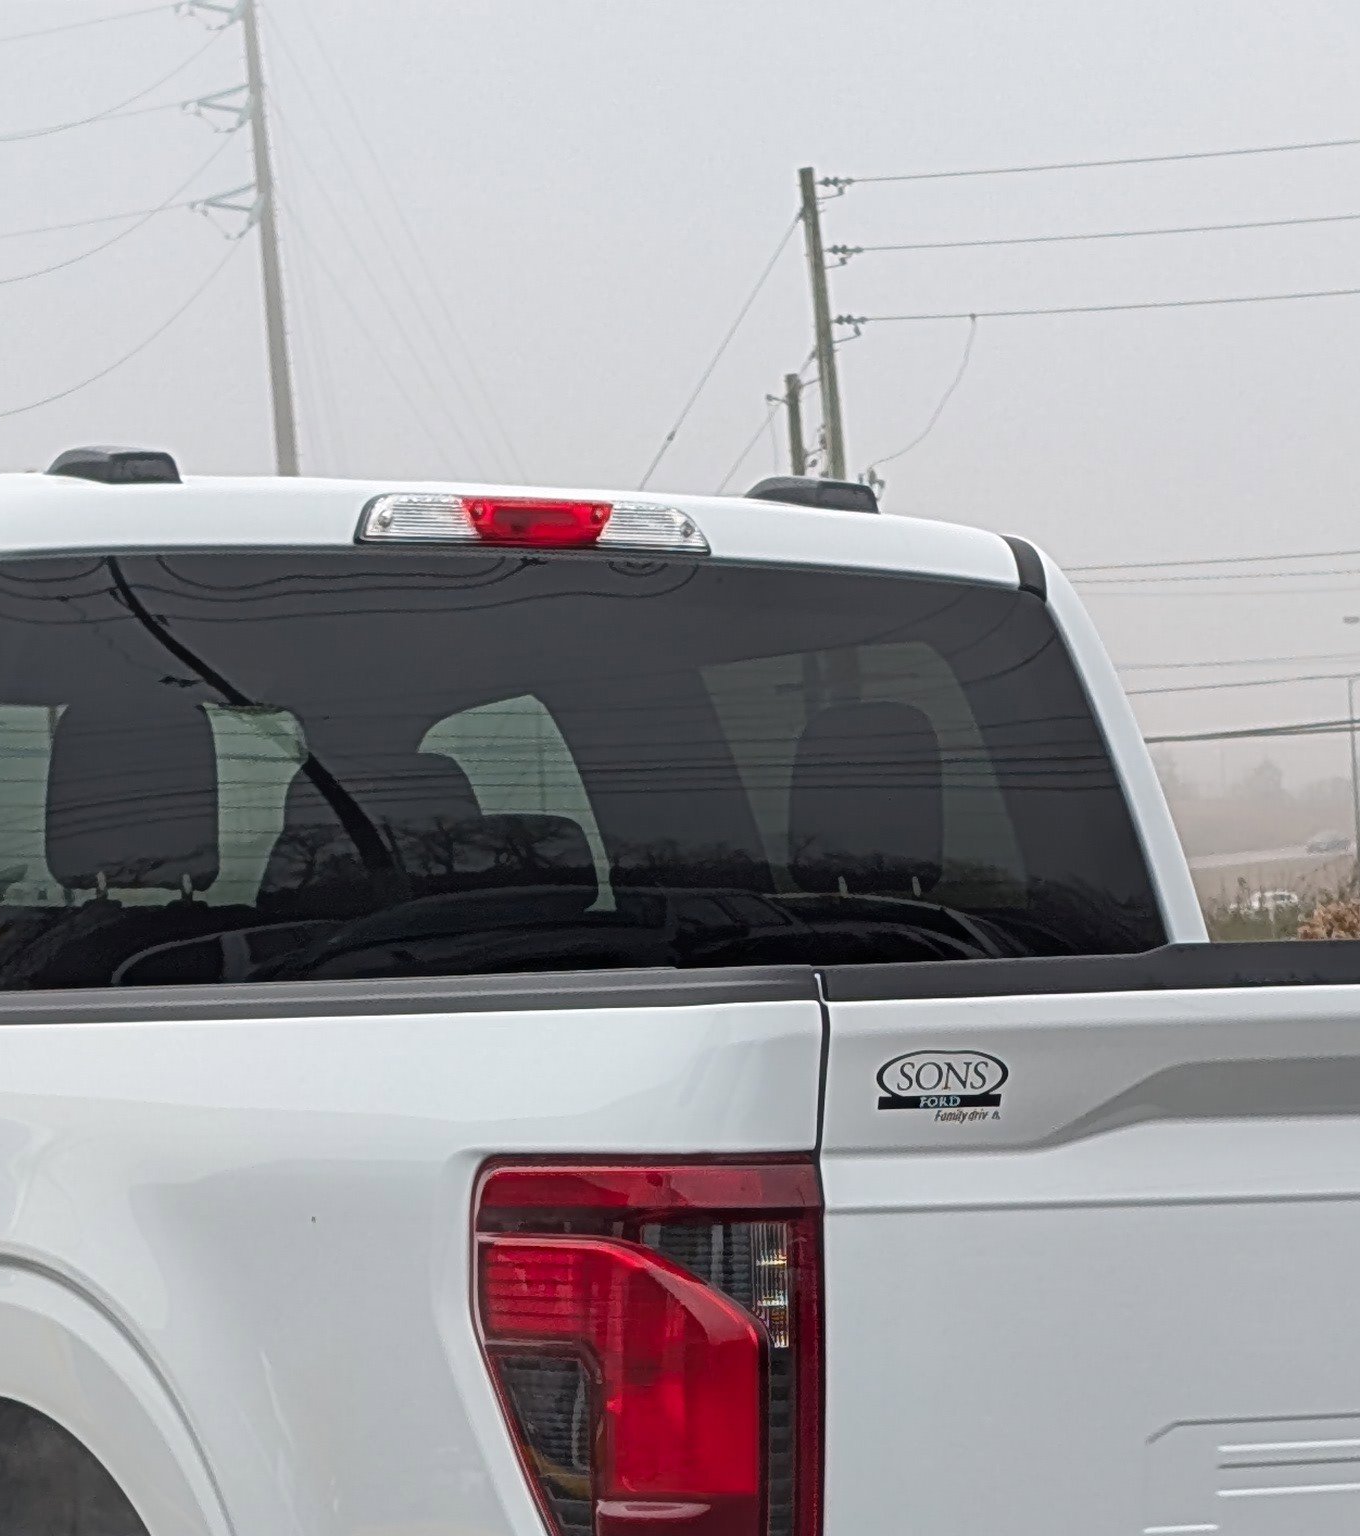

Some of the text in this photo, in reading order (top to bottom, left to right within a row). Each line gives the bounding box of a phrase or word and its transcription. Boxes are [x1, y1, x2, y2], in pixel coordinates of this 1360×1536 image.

[896, 1060, 989, 1091] SONS
[919, 1096, 961, 1109] FORD
[934, 1109, 968, 1124] Family
